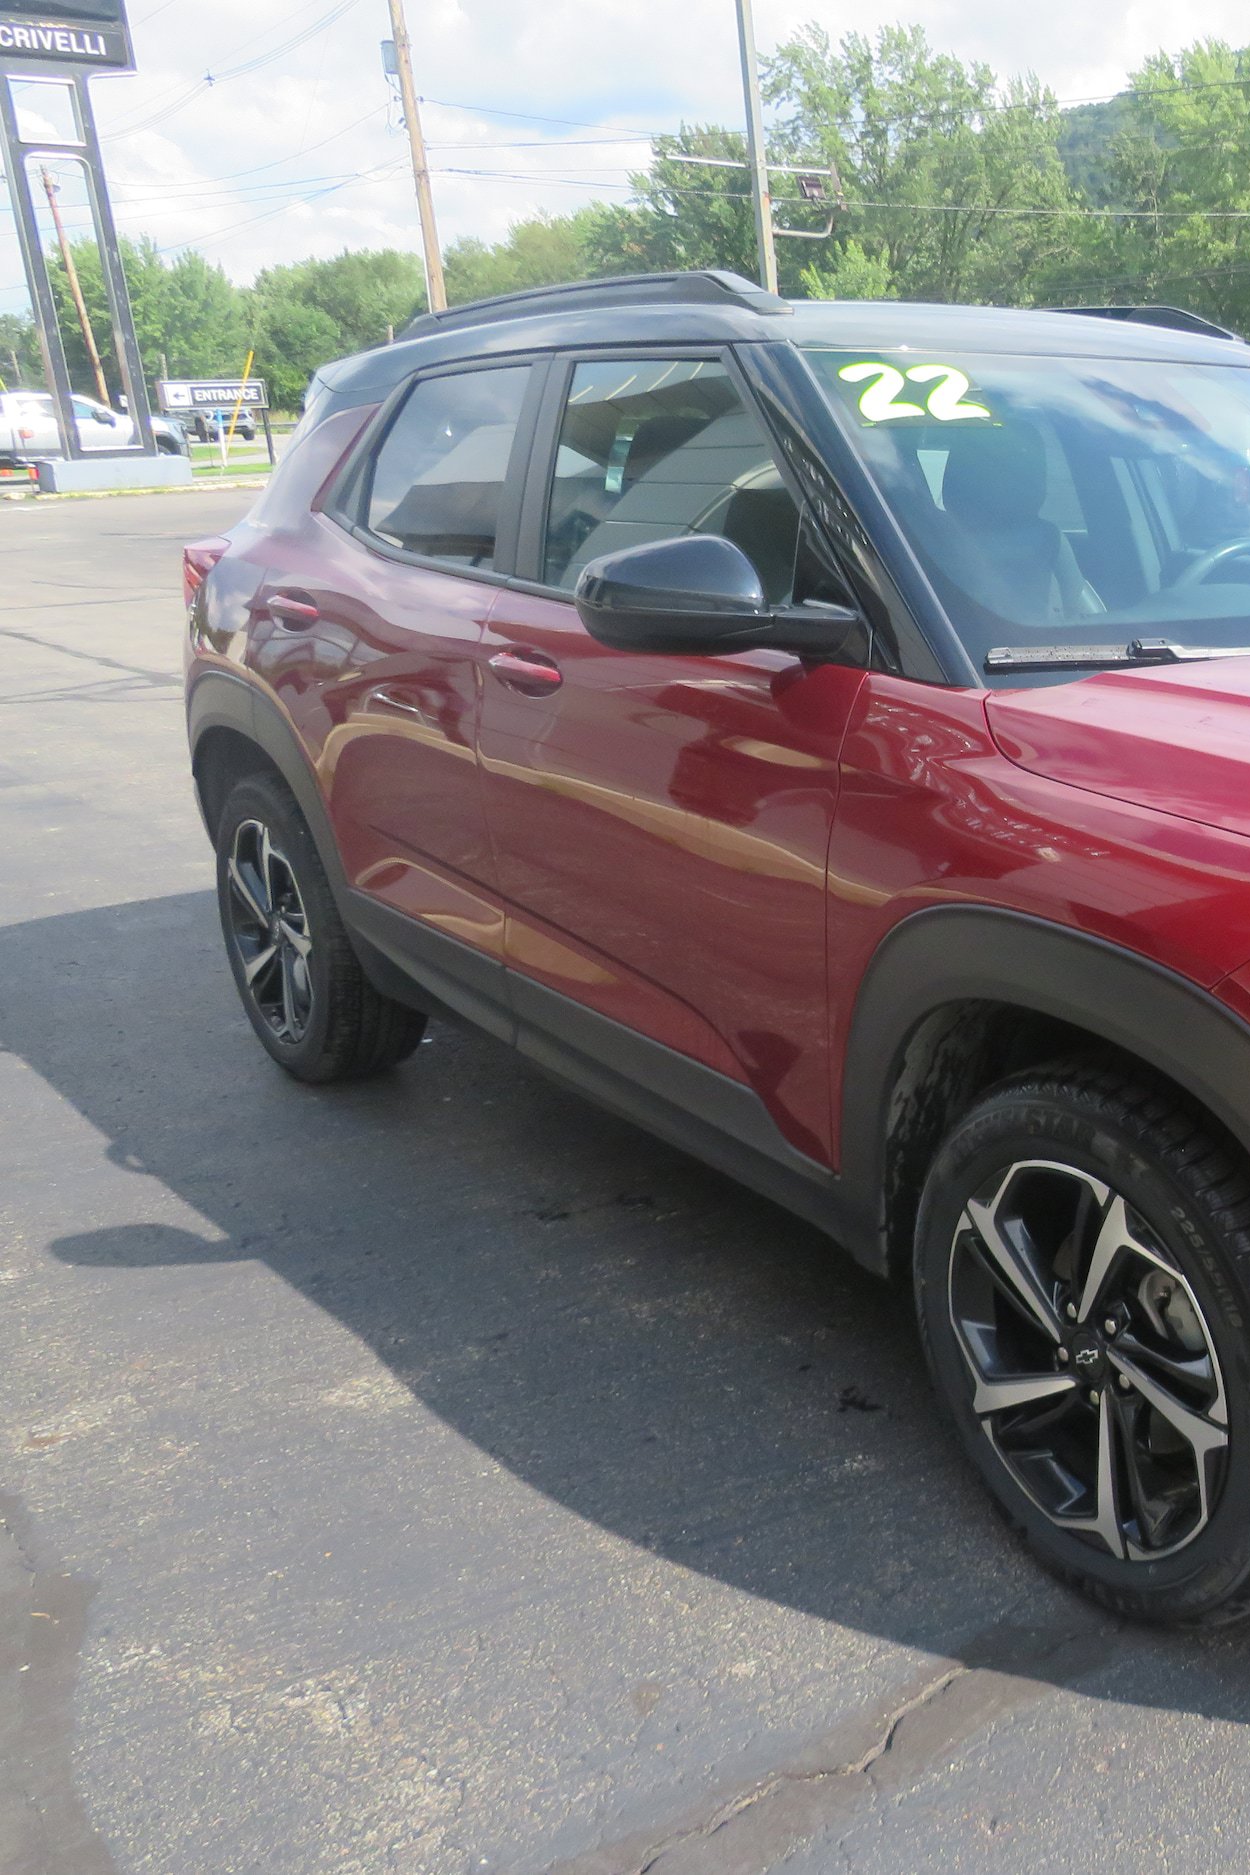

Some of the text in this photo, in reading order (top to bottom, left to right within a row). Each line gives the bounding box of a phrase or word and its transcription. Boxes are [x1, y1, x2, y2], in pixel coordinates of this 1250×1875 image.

[0, 25, 107, 56] CRIVELLI
[194, 387, 259, 402] ENTRANCE
[838, 361, 992, 422] 22
